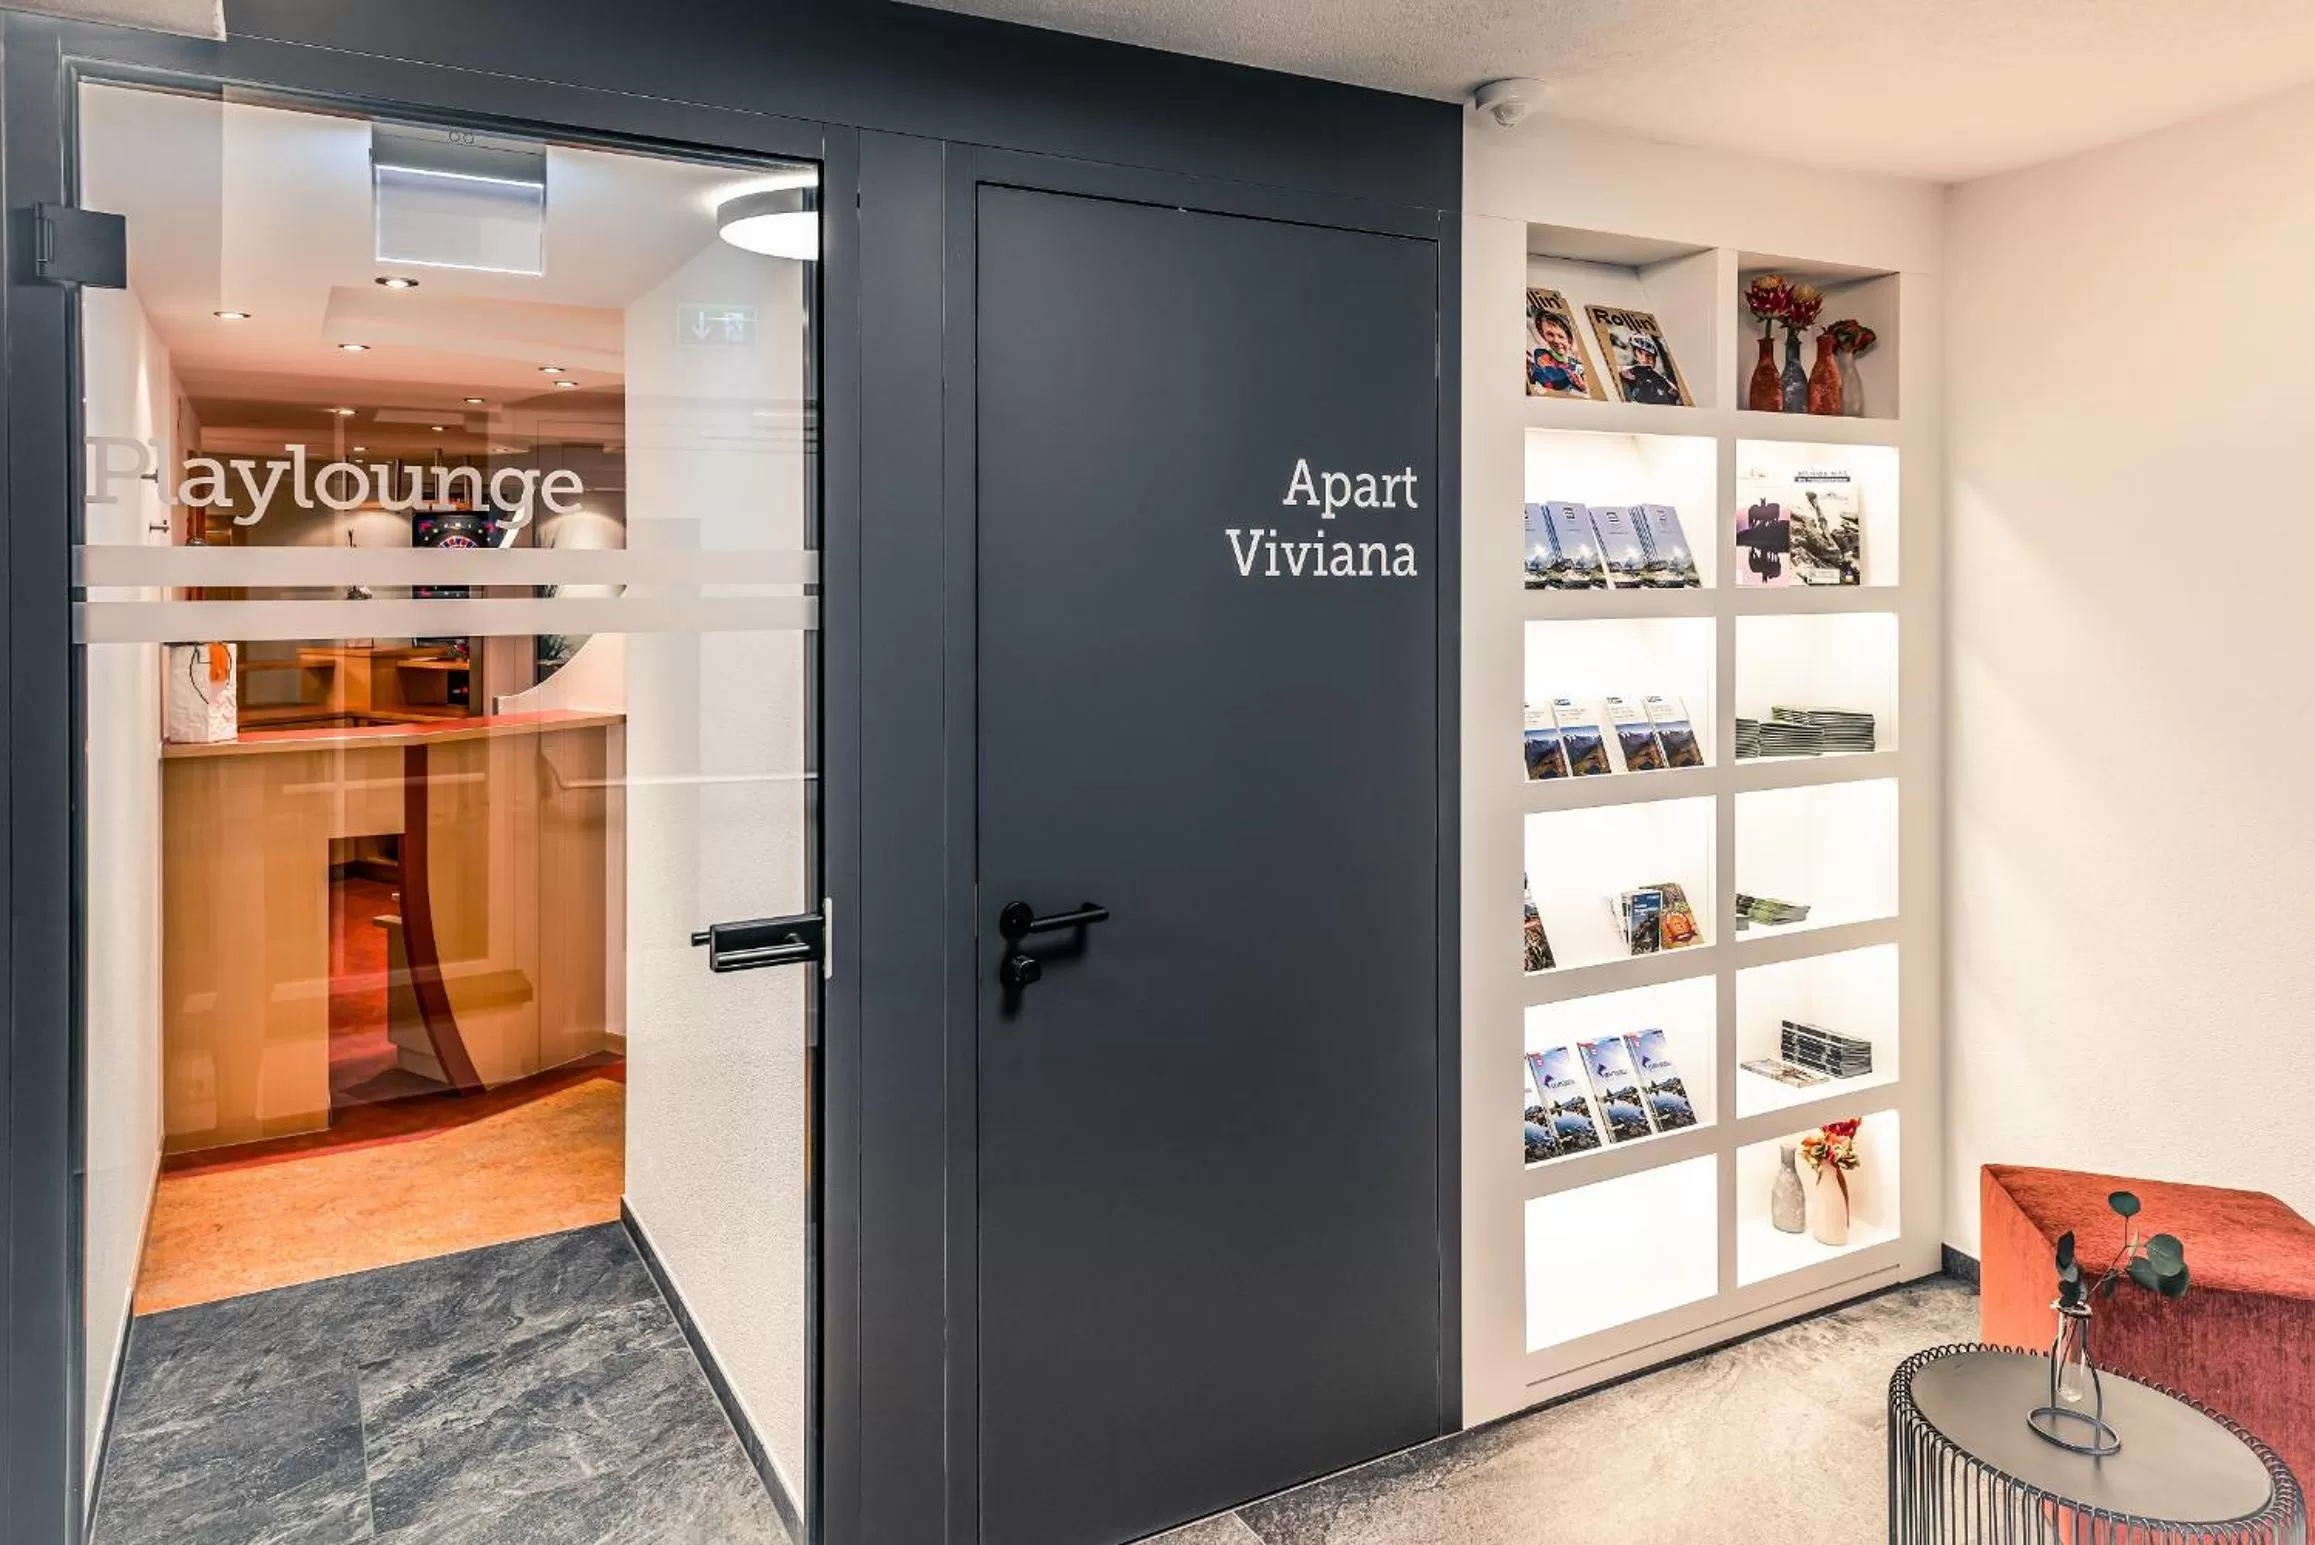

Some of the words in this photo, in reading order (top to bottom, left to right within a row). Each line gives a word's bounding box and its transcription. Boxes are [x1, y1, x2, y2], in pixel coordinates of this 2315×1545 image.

[1526, 290, 1562, 310] llin'
[84, 436, 585, 528] Playlounge
[1282, 458, 1418, 519] Apart
[1225, 529, 1418, 576] Viviana
